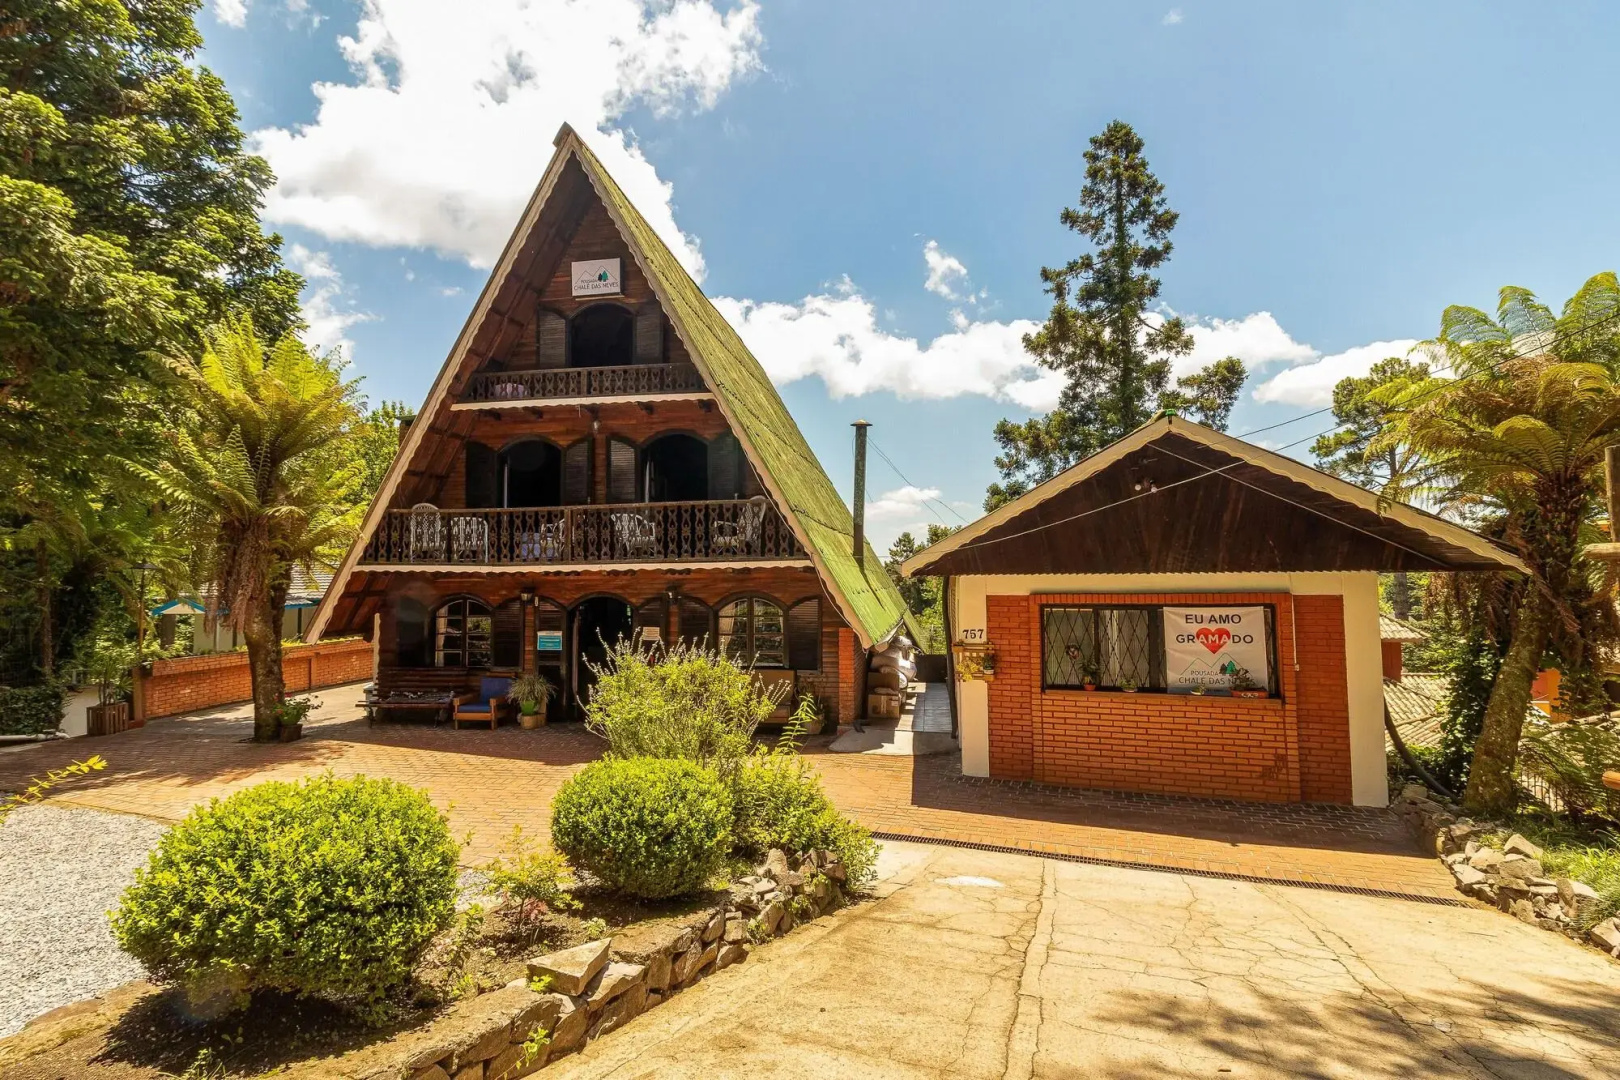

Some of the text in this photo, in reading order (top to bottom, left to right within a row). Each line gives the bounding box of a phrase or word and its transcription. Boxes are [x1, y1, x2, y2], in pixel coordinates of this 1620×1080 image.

[1185, 614, 1242, 624] EU AMO
[962, 629, 984, 639] 757
[1176, 634, 1254, 644] GRAMADO
[1208, 677, 1226, 685] DAS
